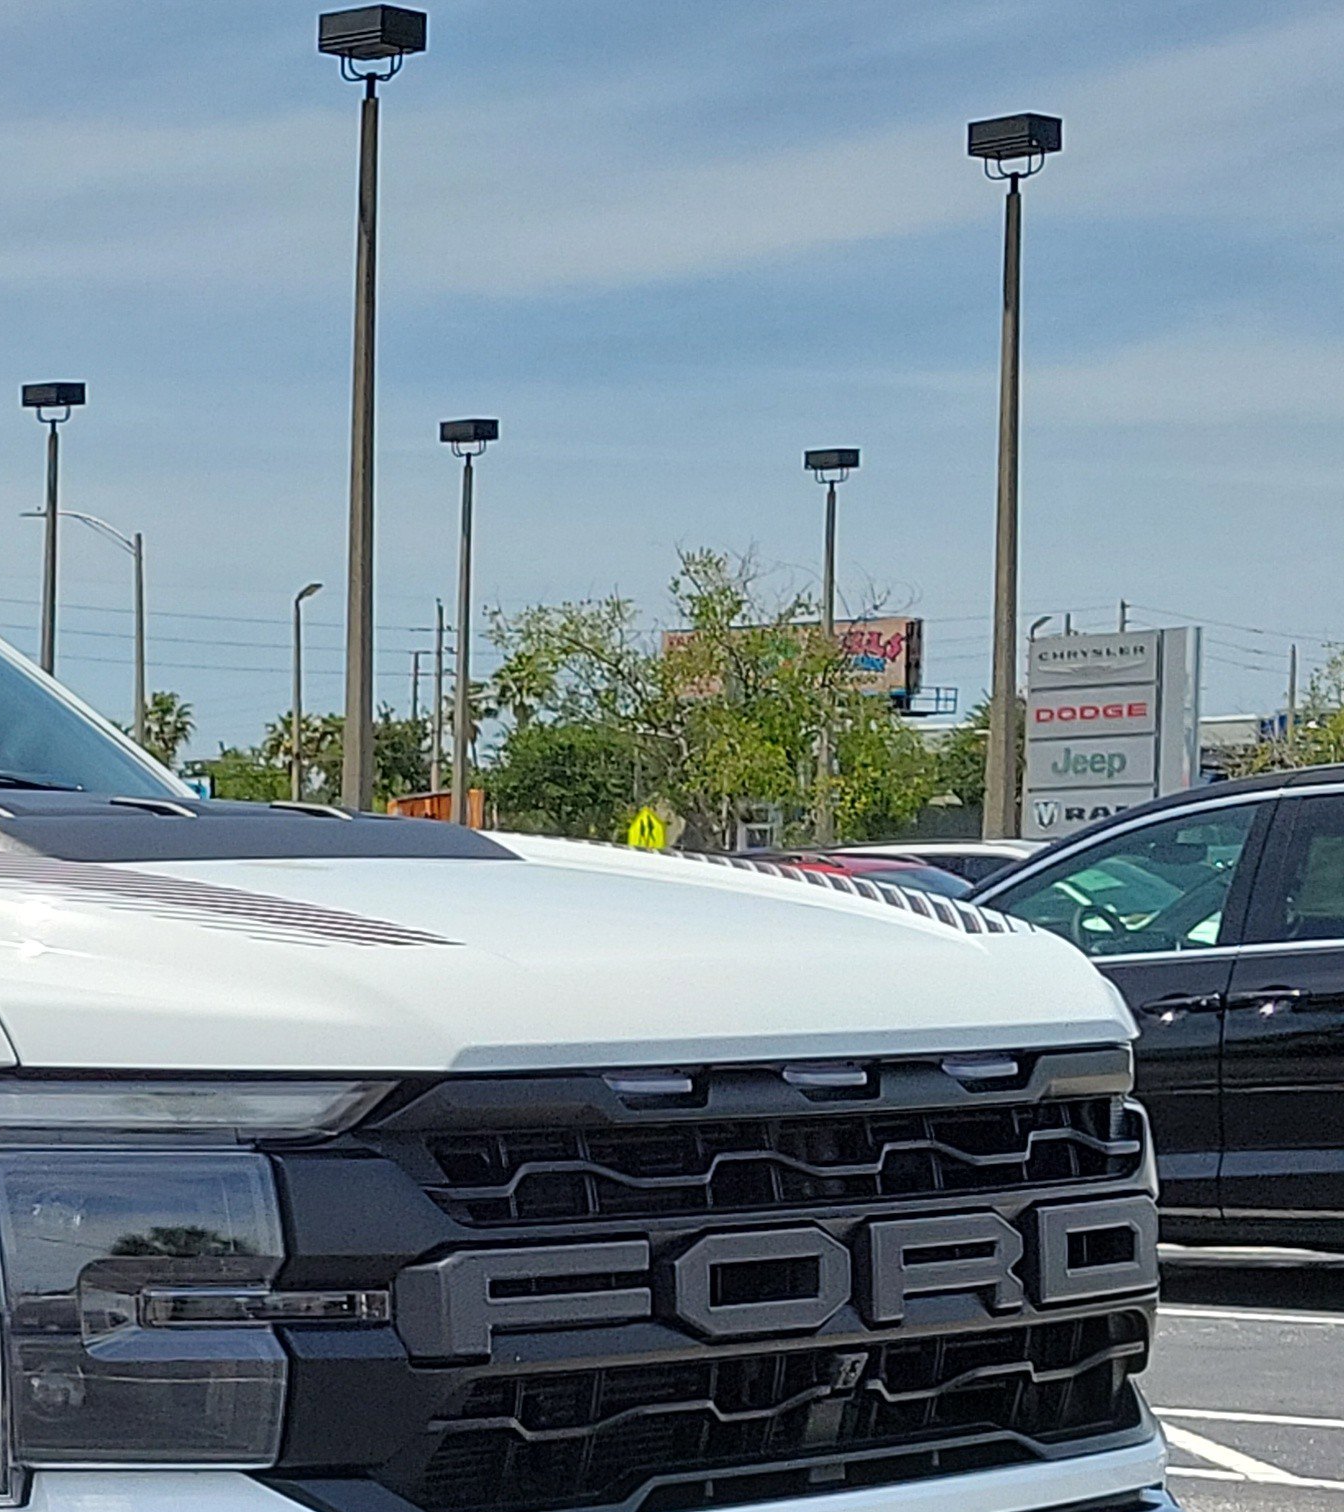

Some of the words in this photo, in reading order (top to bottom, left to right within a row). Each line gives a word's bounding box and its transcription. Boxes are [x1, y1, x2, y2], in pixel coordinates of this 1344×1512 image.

[1038, 645, 1146, 661] CHRYSLER
[1035, 702, 1148, 723] DODGE
[1051, 747, 1127, 778] Jeep
[1064, 805, 1130, 821] RA
[396, 1196, 1159, 1360] FORD
